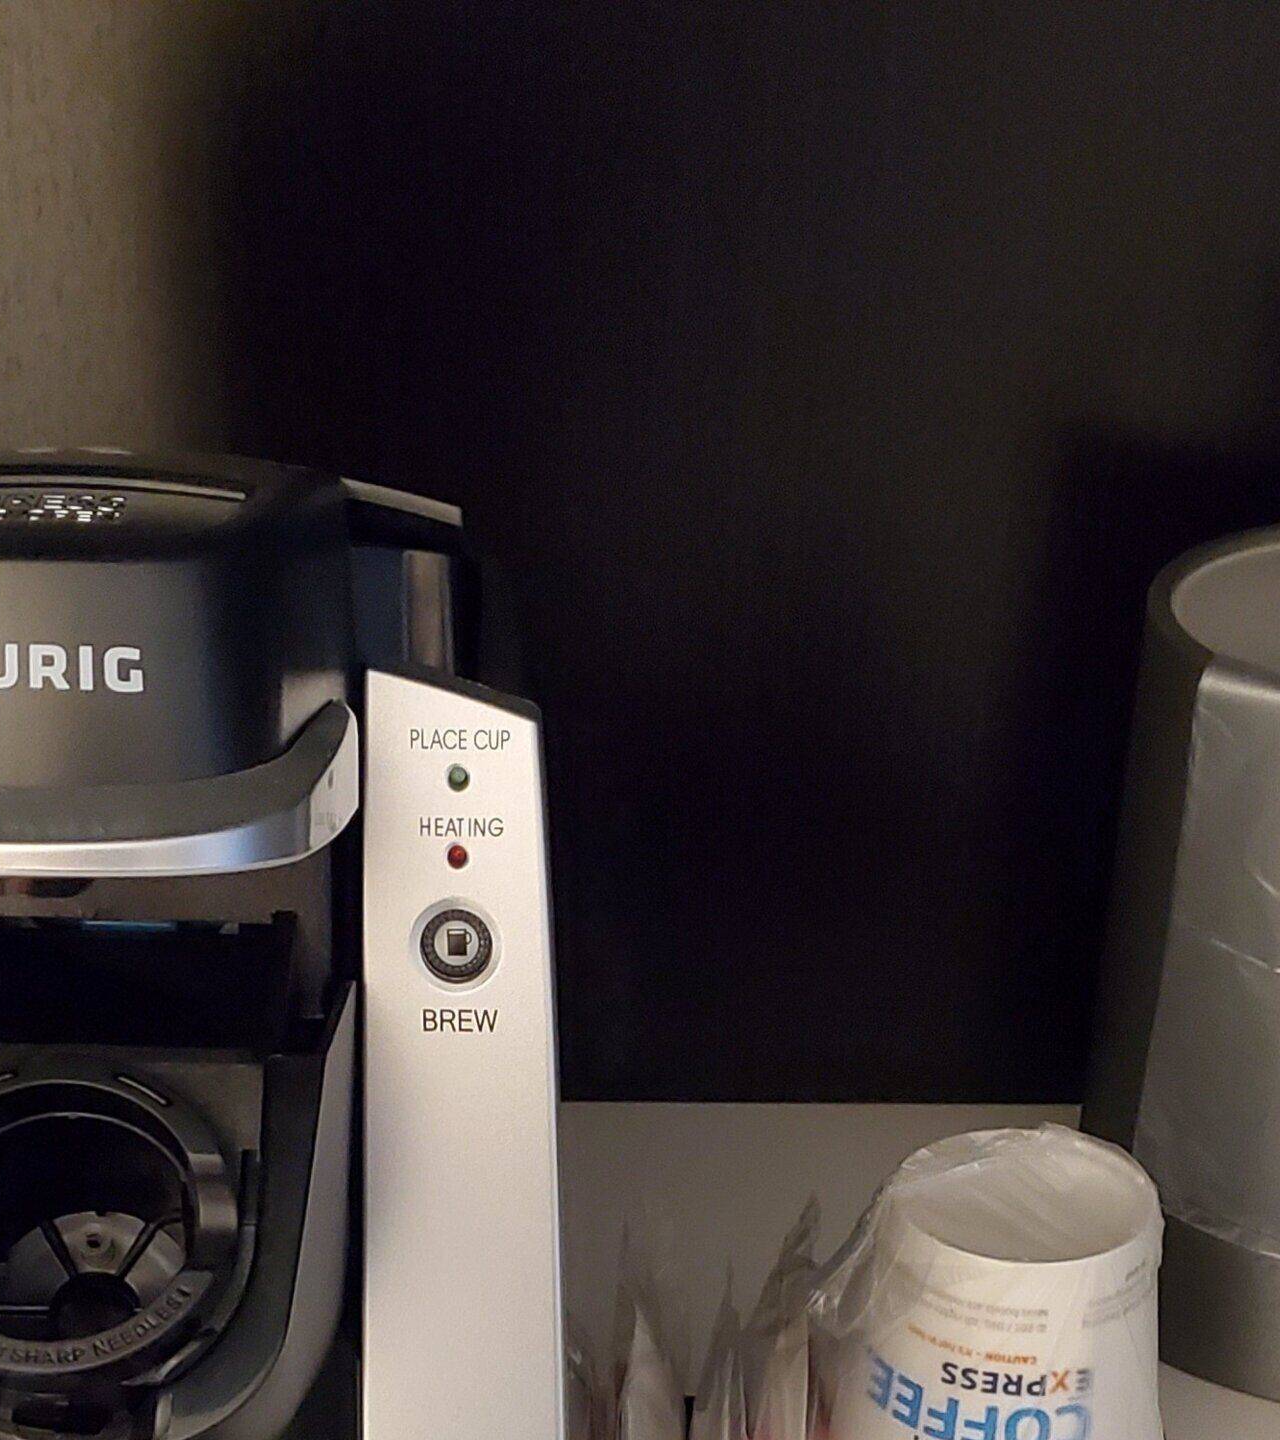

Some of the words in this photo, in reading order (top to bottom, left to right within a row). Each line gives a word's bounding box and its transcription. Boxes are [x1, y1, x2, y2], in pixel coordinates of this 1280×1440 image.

[409, 728, 468, 750] PLACE
[473, 729, 511, 750] CUP
[419, 817, 504, 838] HEATING
[422, 1008, 499, 1033] BREW
[984, 1352, 1038, 1365] CAUTION
[940, 1362, 1093, 1397] EXPRESS
